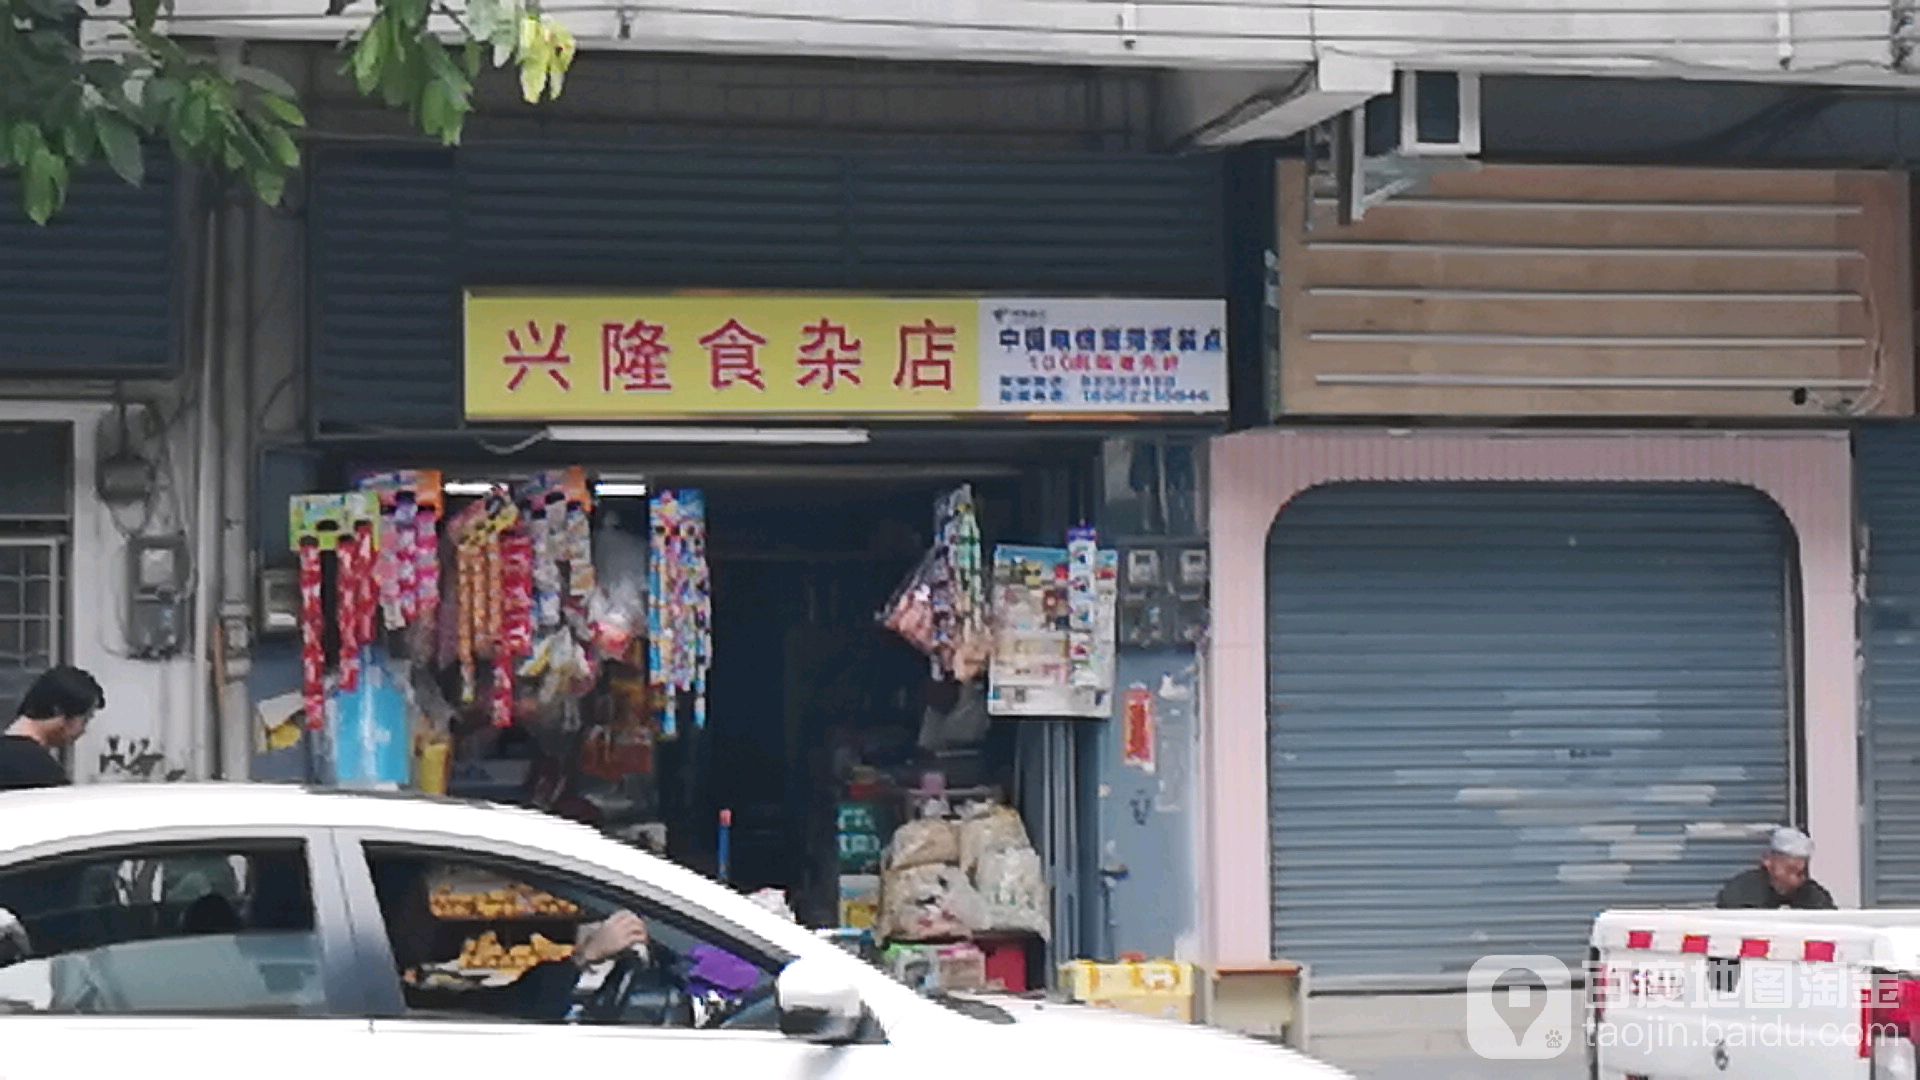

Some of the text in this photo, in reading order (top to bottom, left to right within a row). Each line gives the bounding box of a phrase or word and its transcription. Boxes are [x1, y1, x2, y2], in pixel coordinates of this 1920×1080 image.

[503, 318, 956, 391] 兴隆食杂店
